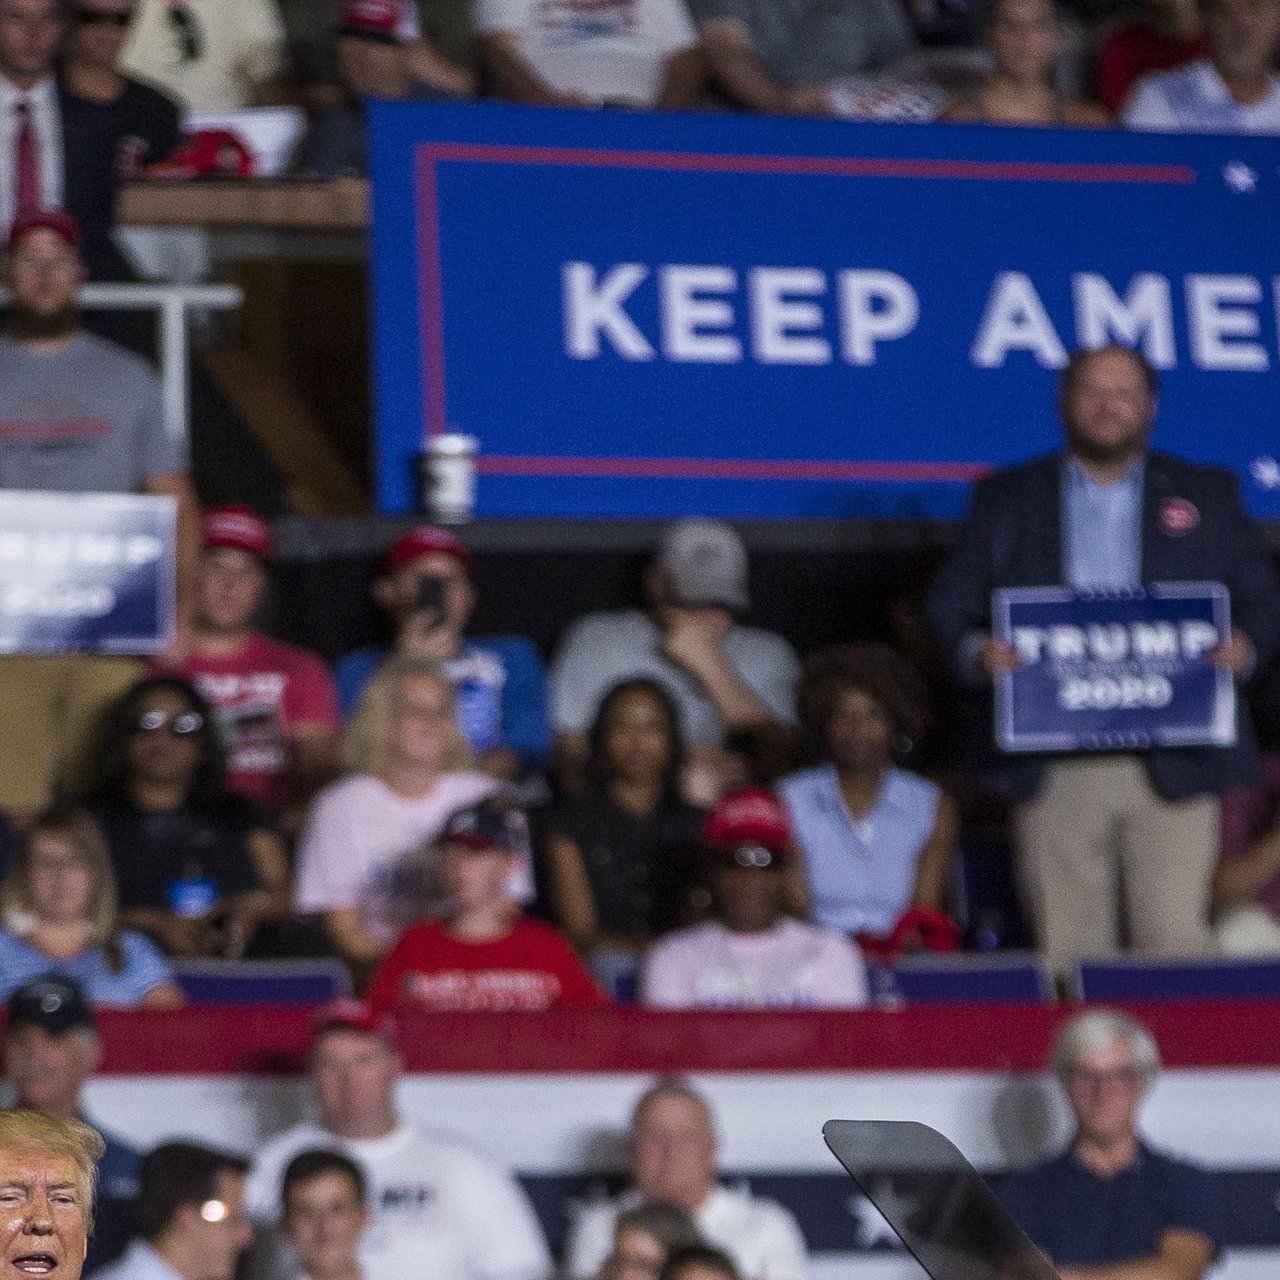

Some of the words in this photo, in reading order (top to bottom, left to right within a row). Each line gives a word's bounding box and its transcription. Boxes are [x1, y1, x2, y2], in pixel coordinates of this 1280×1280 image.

[561, 260, 920, 367] KEEP
[1013, 619, 1219, 664] TRUMP
[1058, 673, 1173, 711] 2020
